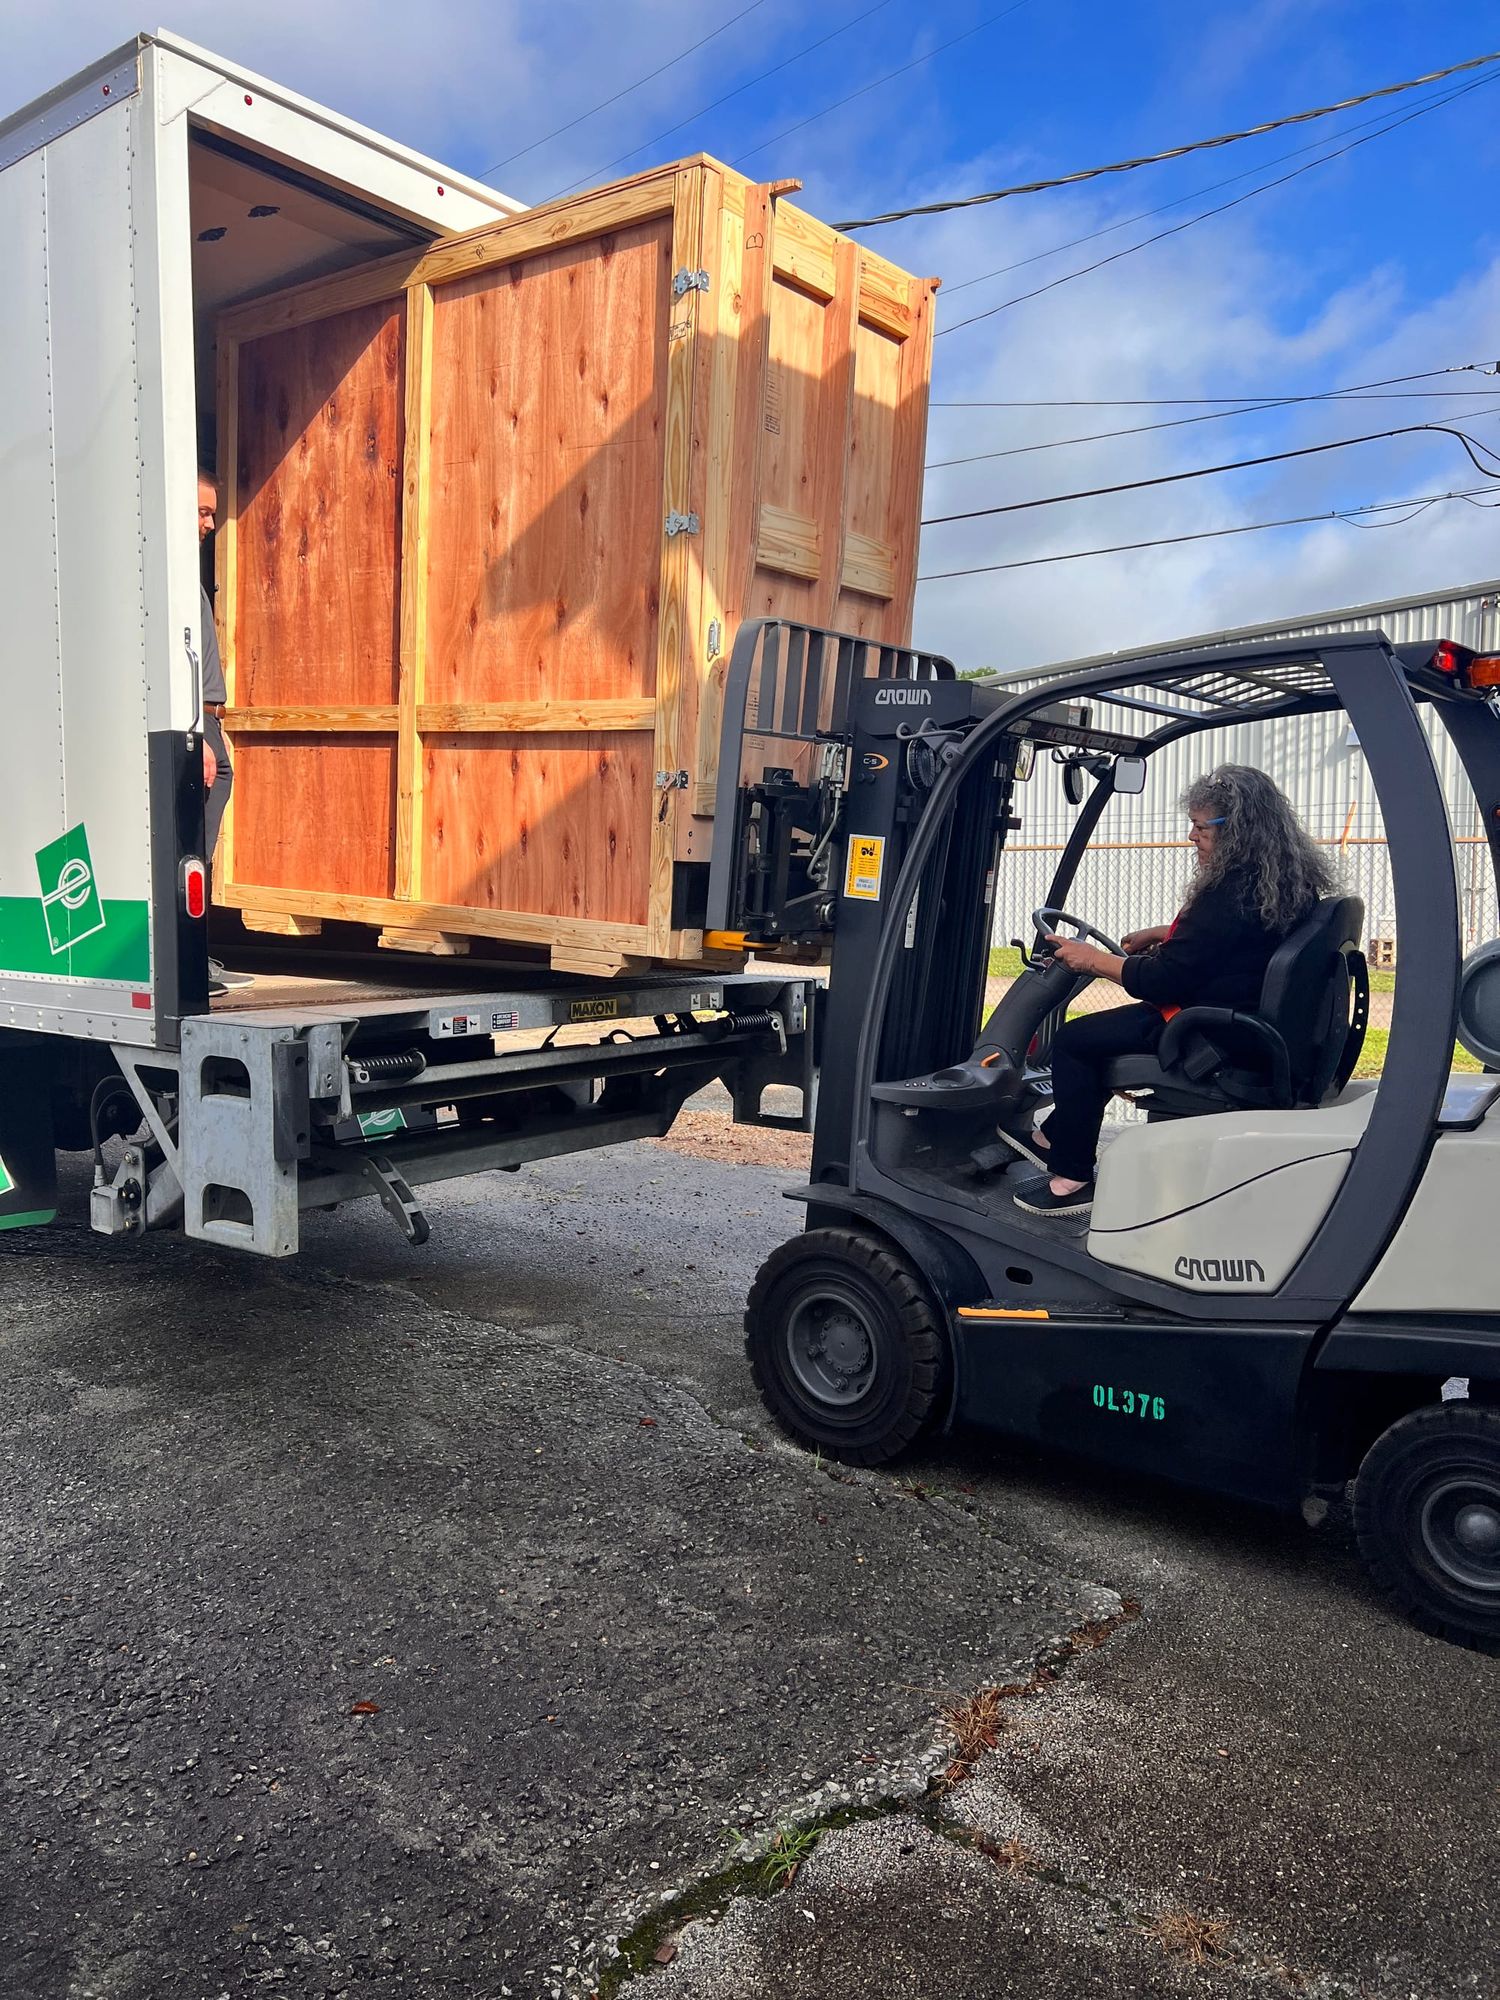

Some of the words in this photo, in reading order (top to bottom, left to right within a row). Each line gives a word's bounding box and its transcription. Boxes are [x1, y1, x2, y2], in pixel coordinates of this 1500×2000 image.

[875, 688, 932, 705] CROWN
[571, 1002, 615, 1018] MAXON
[1174, 1255, 1265, 1282] CROWN
